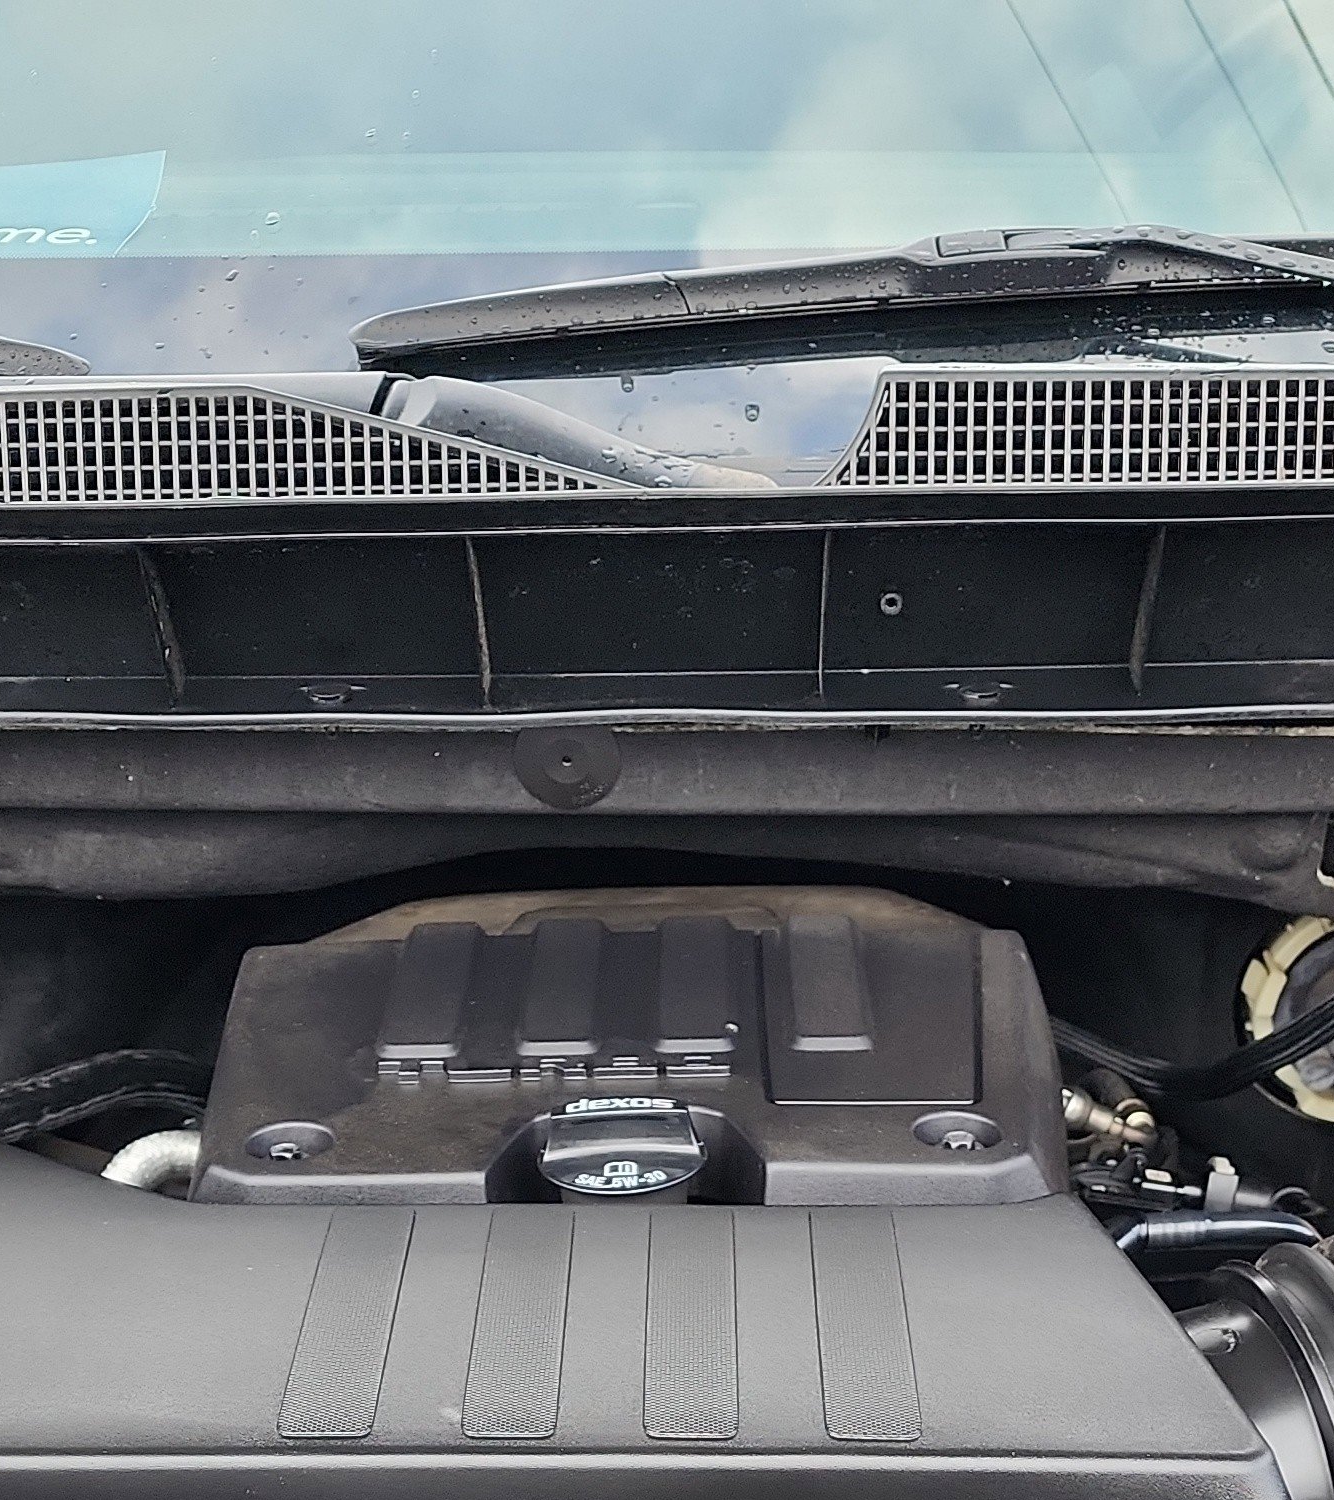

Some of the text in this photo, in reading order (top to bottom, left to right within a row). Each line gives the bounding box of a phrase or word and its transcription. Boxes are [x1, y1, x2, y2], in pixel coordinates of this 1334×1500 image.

[565, 1098, 677, 1113] dexos
[574, 1169, 668, 1188] SAE 5W-30
